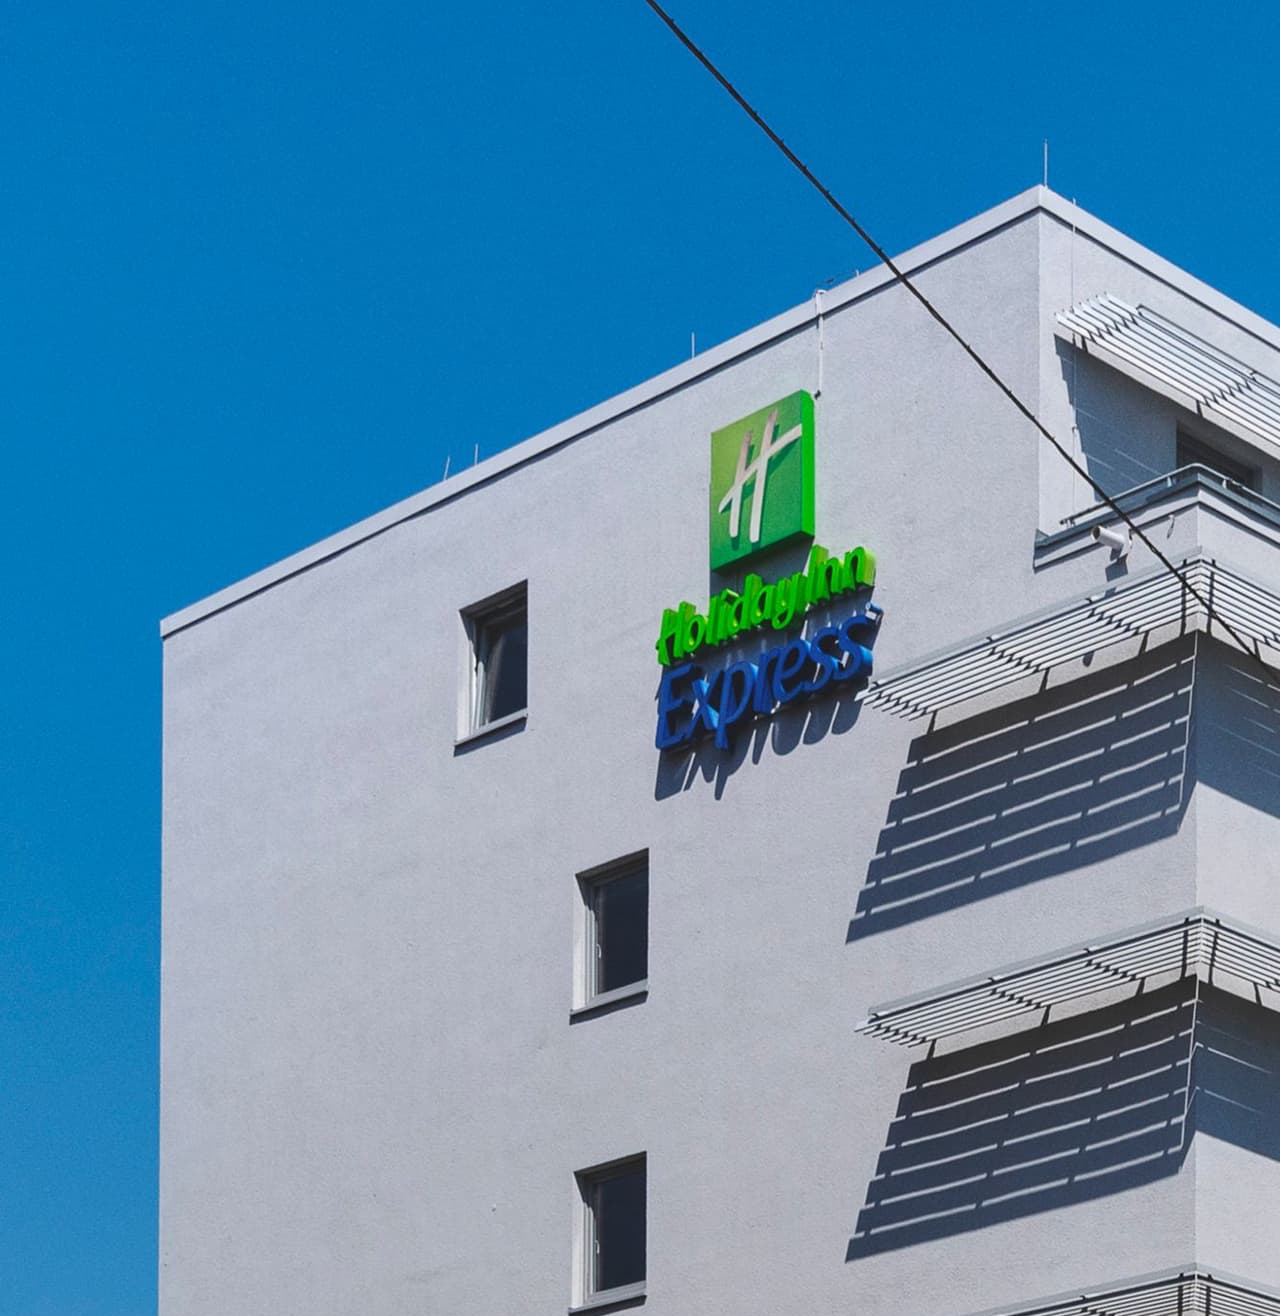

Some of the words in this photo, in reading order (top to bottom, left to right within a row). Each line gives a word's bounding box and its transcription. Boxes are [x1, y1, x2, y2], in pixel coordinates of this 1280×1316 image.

[656, 573, 808, 666] Holiday
[805, 544, 877, 602] Inn
[655, 614, 874, 750] Express
